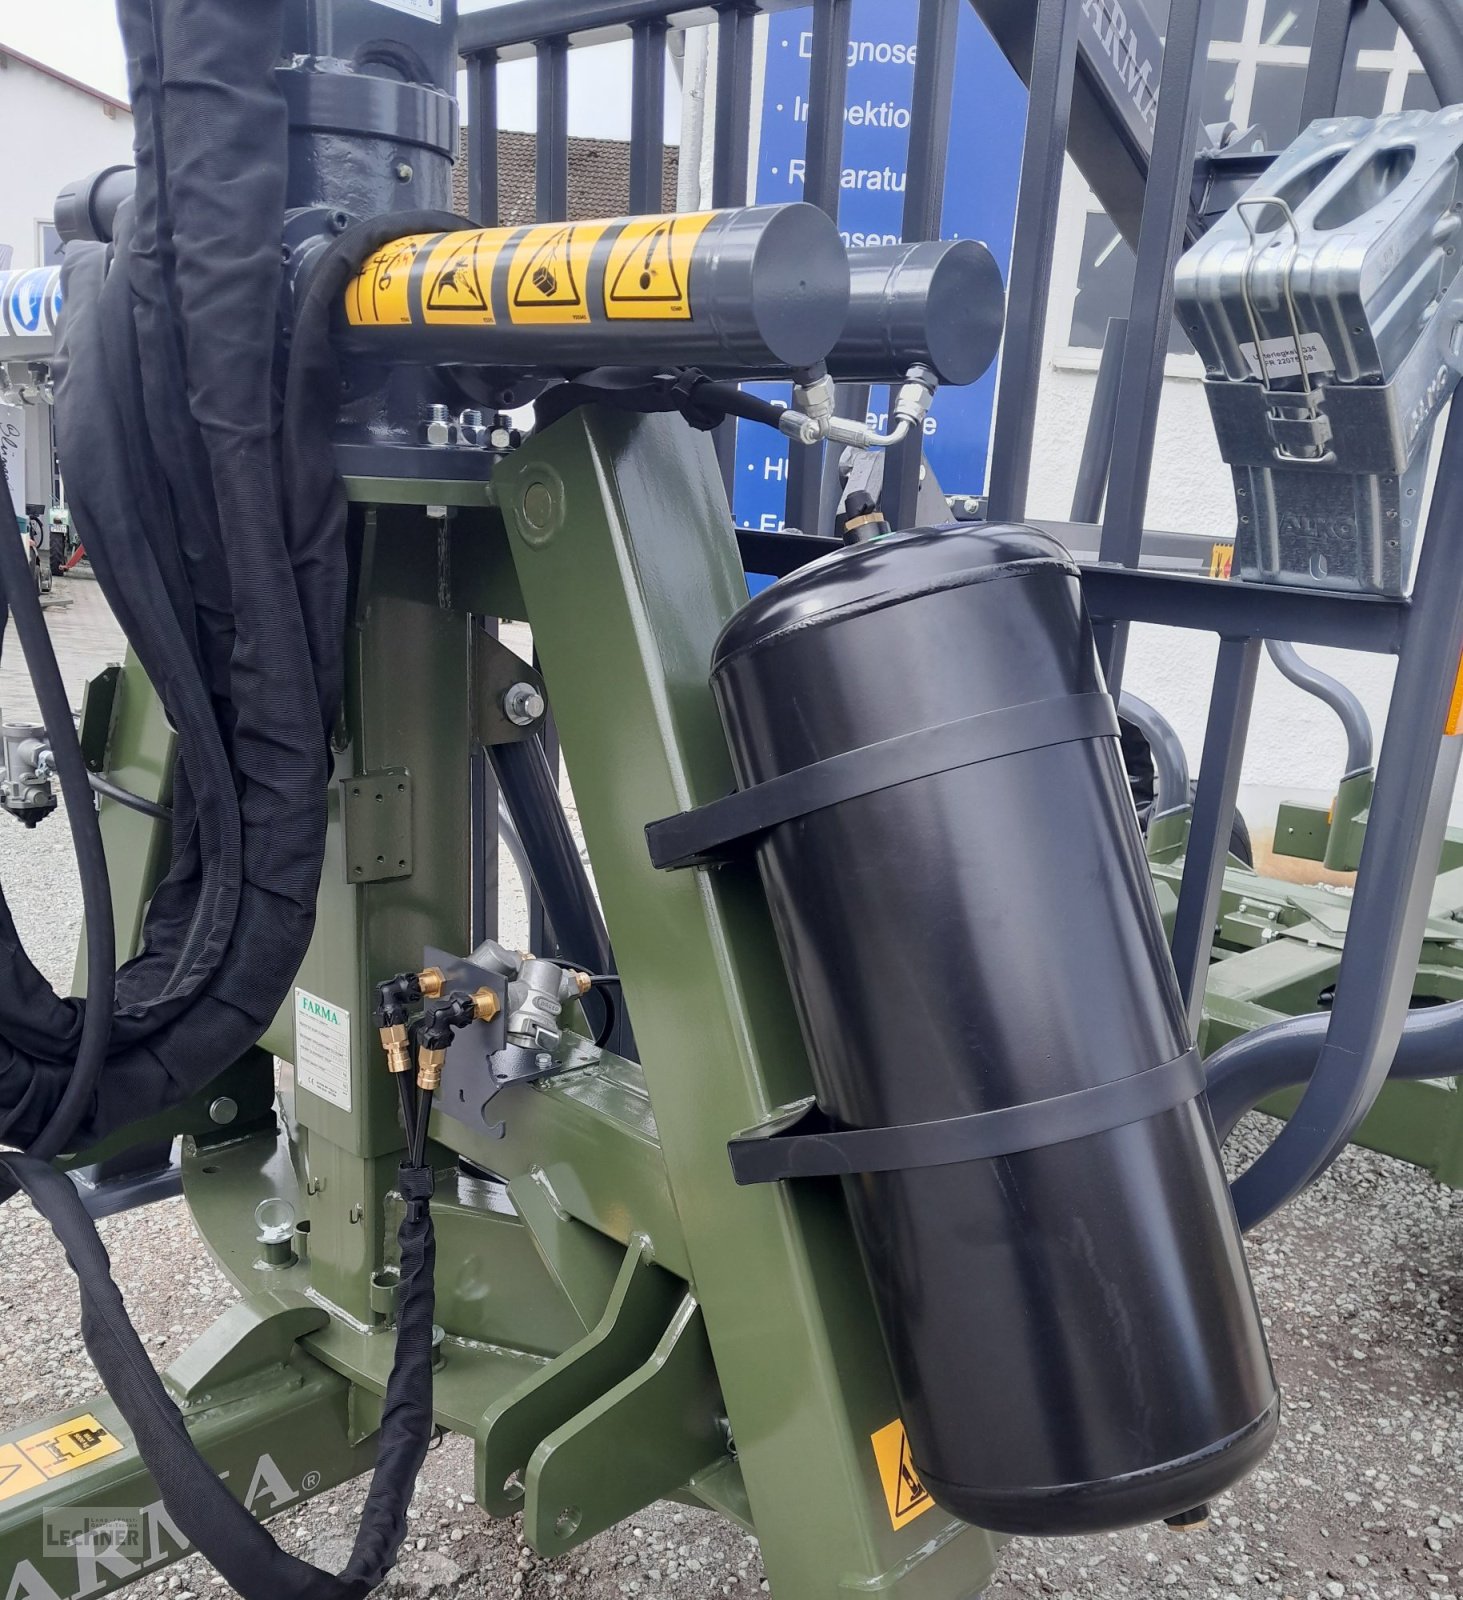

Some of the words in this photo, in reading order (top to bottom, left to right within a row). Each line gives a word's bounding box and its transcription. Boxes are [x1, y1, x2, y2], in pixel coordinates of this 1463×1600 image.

[799, 31, 917, 67] Dgnose
[788, 159, 907, 192] Raratu
[303, 997, 338, 1025] FARMA
